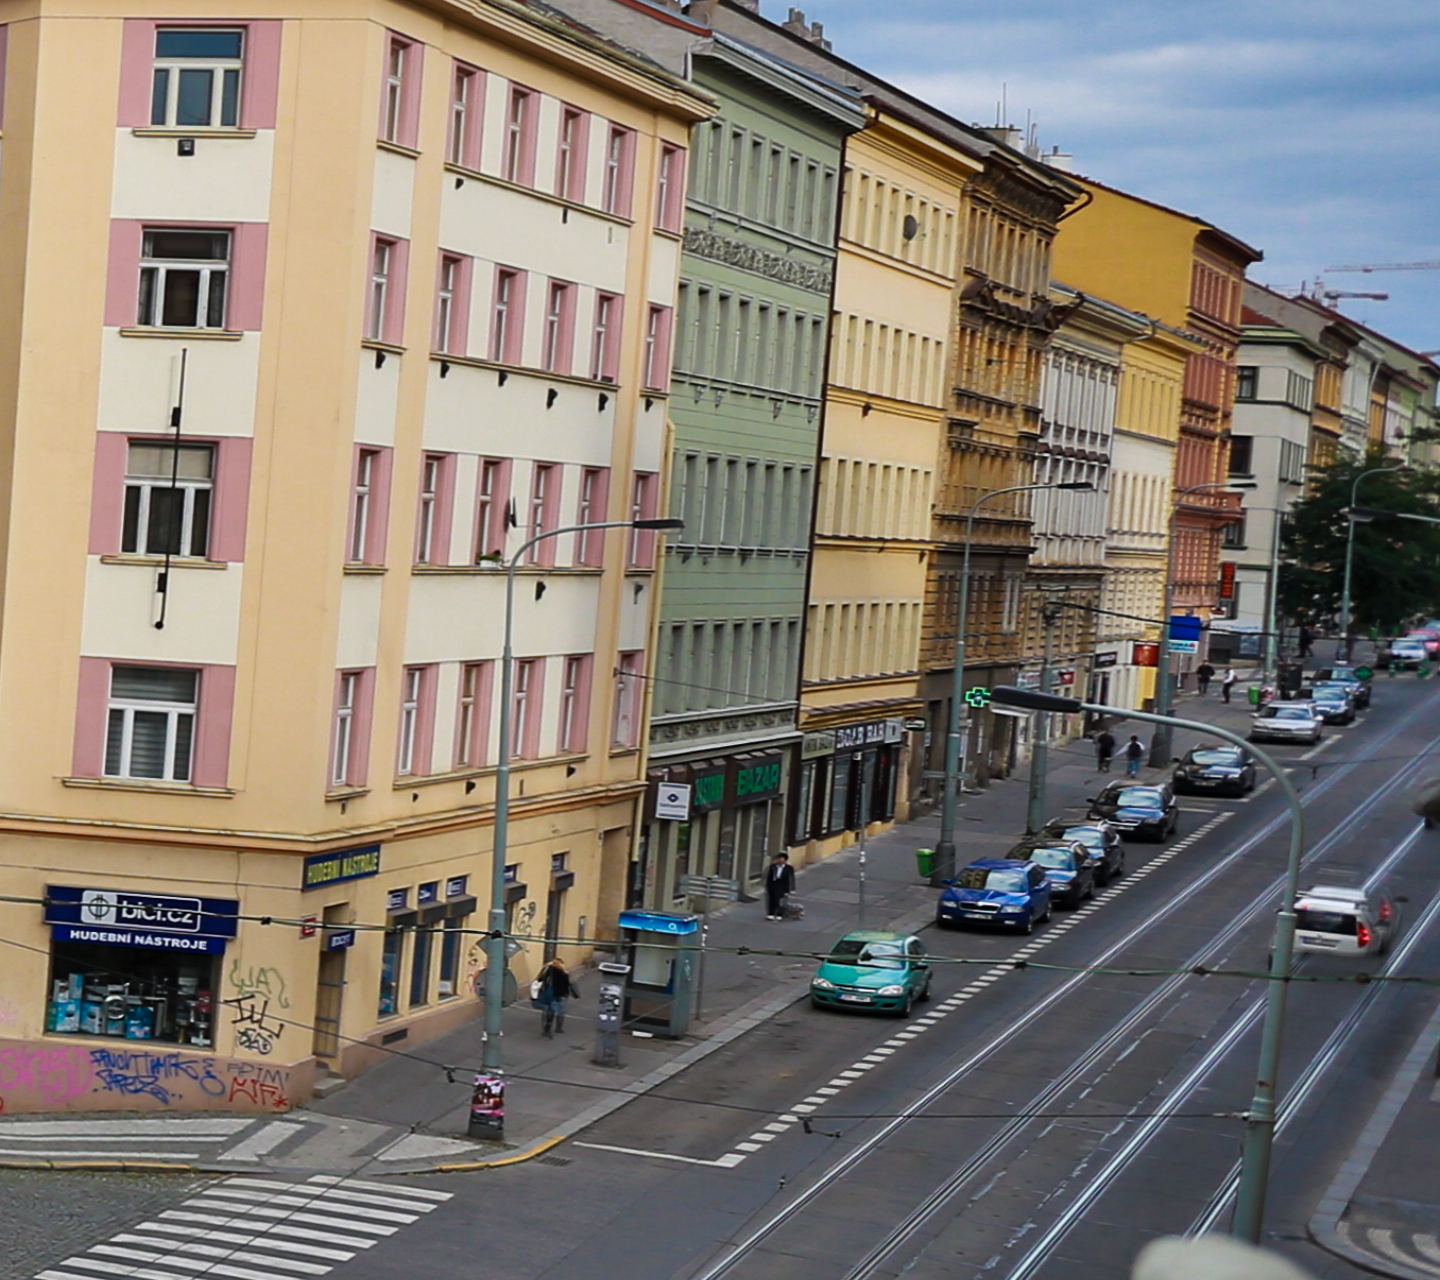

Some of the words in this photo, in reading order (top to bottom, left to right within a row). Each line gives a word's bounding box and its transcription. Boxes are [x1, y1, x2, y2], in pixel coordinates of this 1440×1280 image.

[737, 764, 780, 796] BAZAR
[121, 900, 194, 925] bici.cz
[69, 929, 132, 944] HUDEBNÍ
[134, 933, 208, 951] NÁSTROJE
